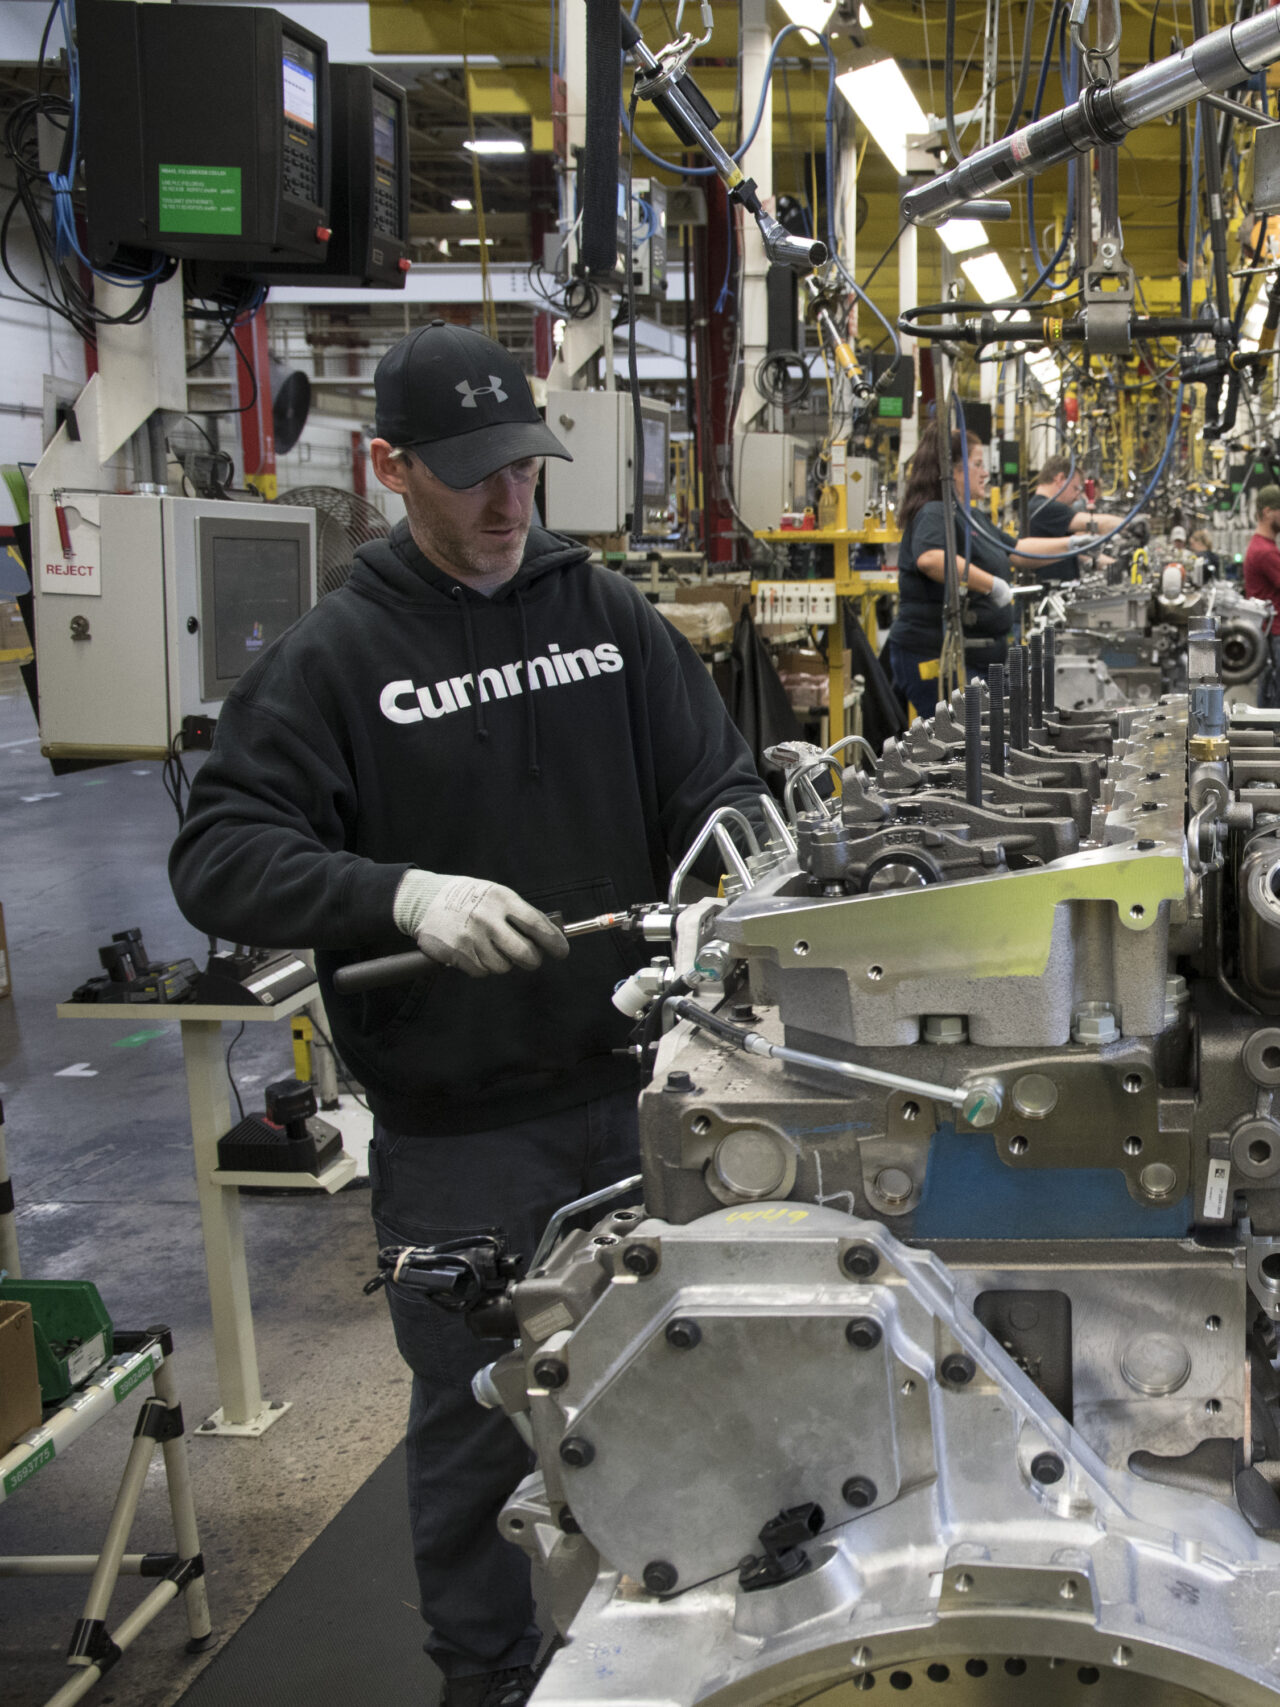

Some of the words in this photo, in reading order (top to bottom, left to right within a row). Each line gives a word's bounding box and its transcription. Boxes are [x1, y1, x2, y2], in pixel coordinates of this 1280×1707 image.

[46, 564, 94, 577] REJECT
[379, 643, 624, 724] Cummins
[9, 1450, 50, 1488] 3693775
